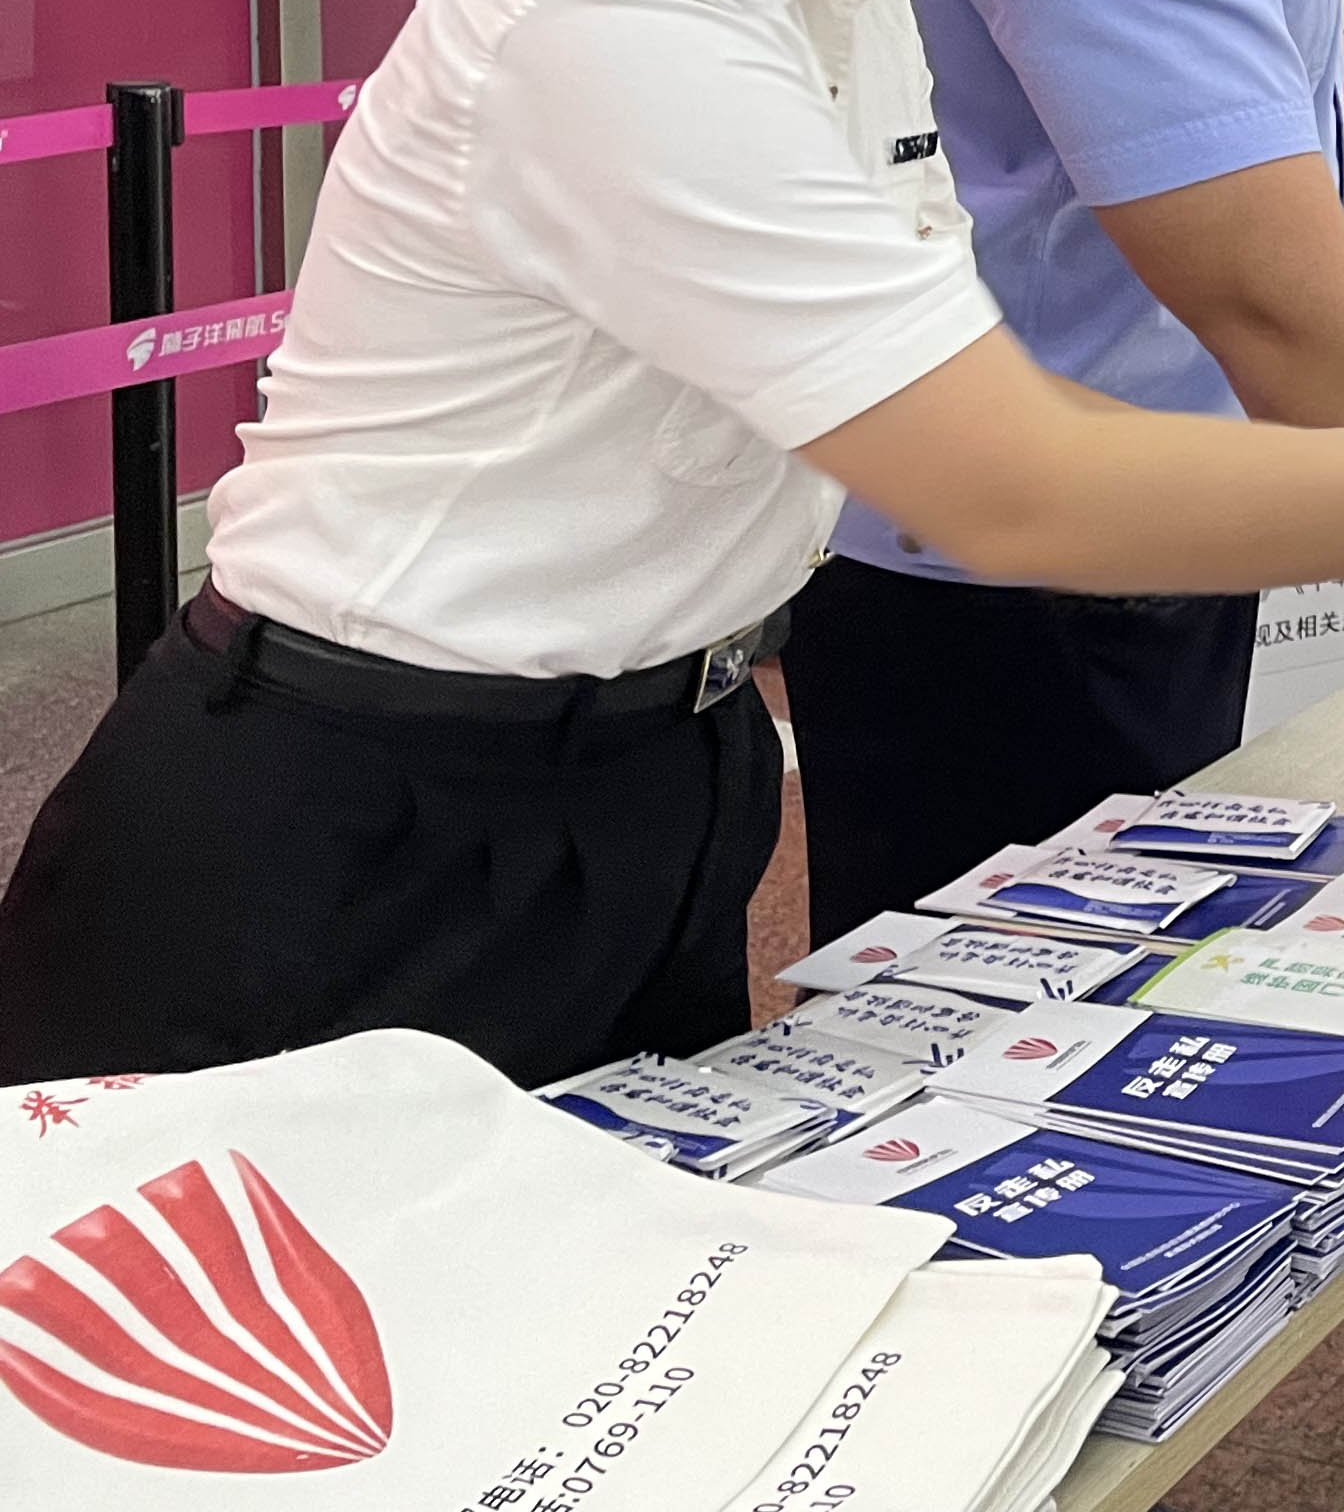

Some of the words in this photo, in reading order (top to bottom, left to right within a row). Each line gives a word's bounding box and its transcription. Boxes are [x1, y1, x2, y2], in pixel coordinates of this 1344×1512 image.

[1120, 1035, 1212, 1099] 反走私
[1161, 1042, 1238, 1100] 宣传册
[953, 1157, 1076, 1217] 反走私
[992, 1168, 1096, 1224] 宣传册
[562, 1241, 749, 1428] 020-82218248
